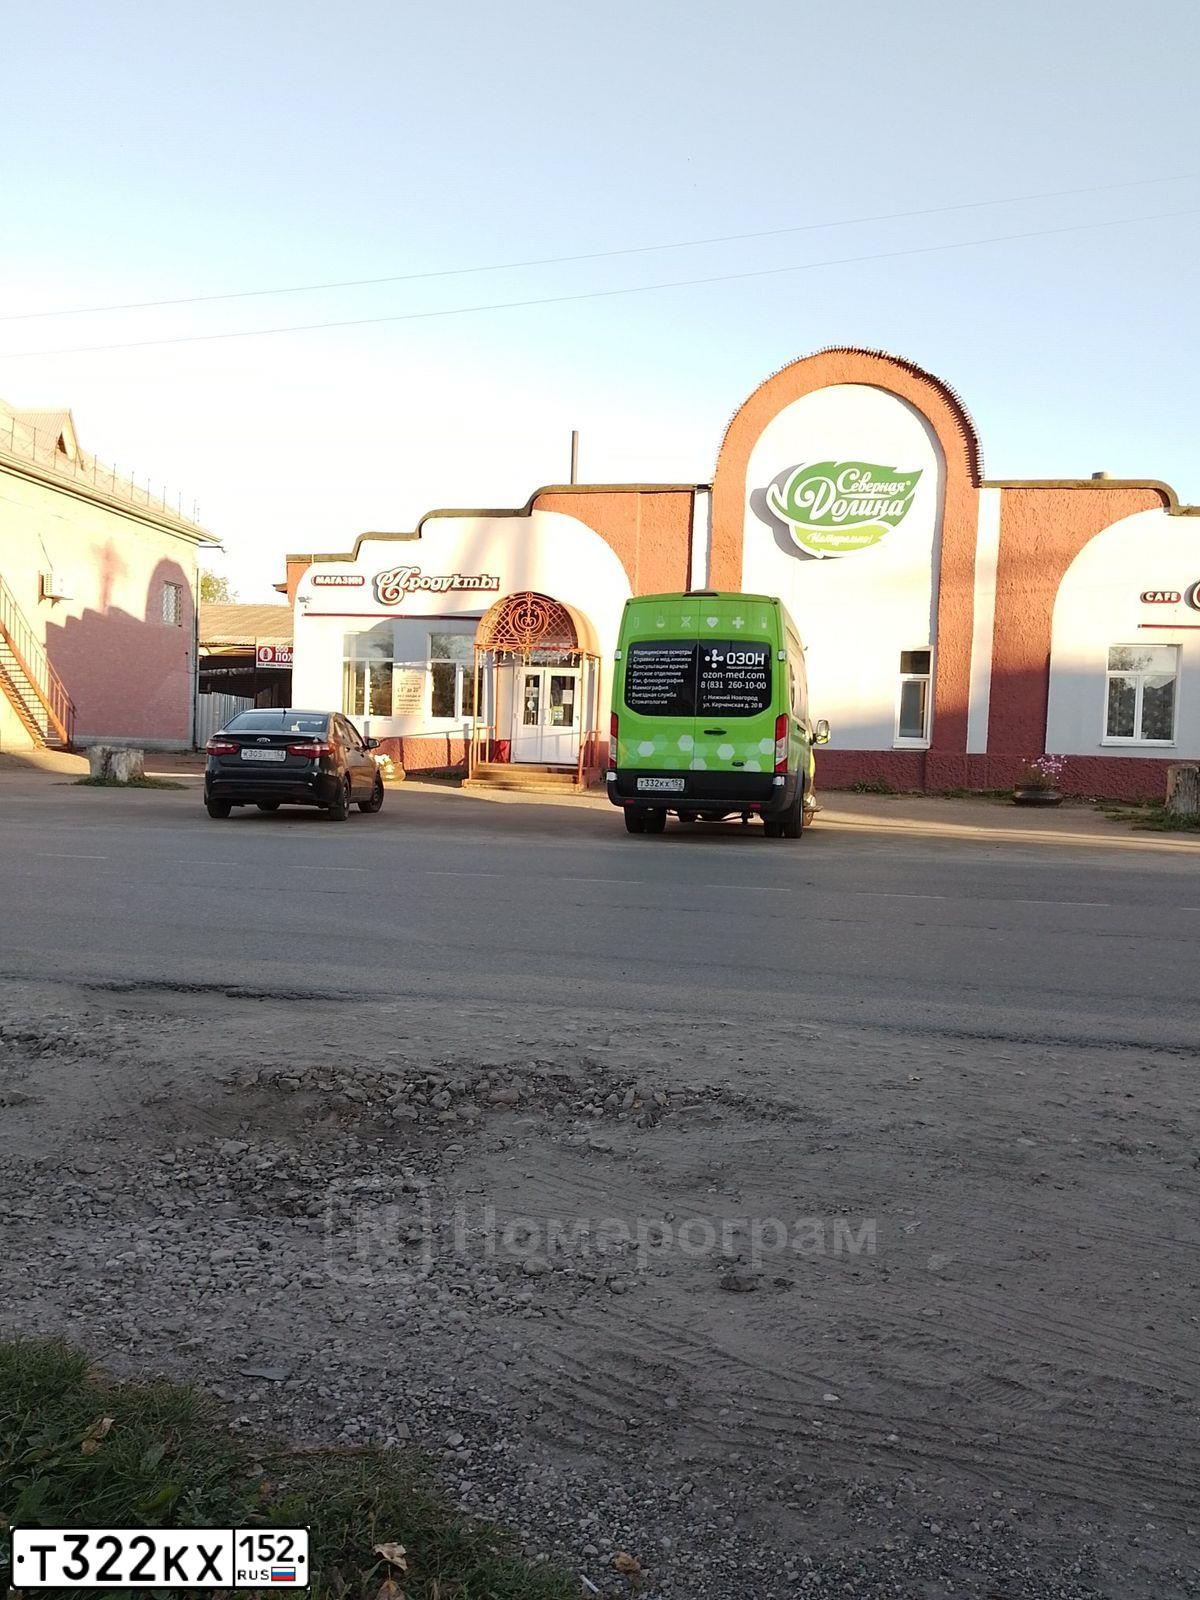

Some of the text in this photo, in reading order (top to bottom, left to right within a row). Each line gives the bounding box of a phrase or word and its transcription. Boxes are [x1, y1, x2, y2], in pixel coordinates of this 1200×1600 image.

[836, 467, 906, 495] Северная
[793, 476, 905, 522] Долина
[315, 576, 364, 586] МАГАЗИН
[374, 567, 500, 606] Продукты
[1144, 591, 1179, 602] CAFE
[726, 652, 765, 666] ОЗОН
[702, 670, 766, 680] ozon-med.com
[700, 680, 706, 689] 8
[727, 681, 767, 690] 260-10-00
[730, 694, 759, 702] Новгород
